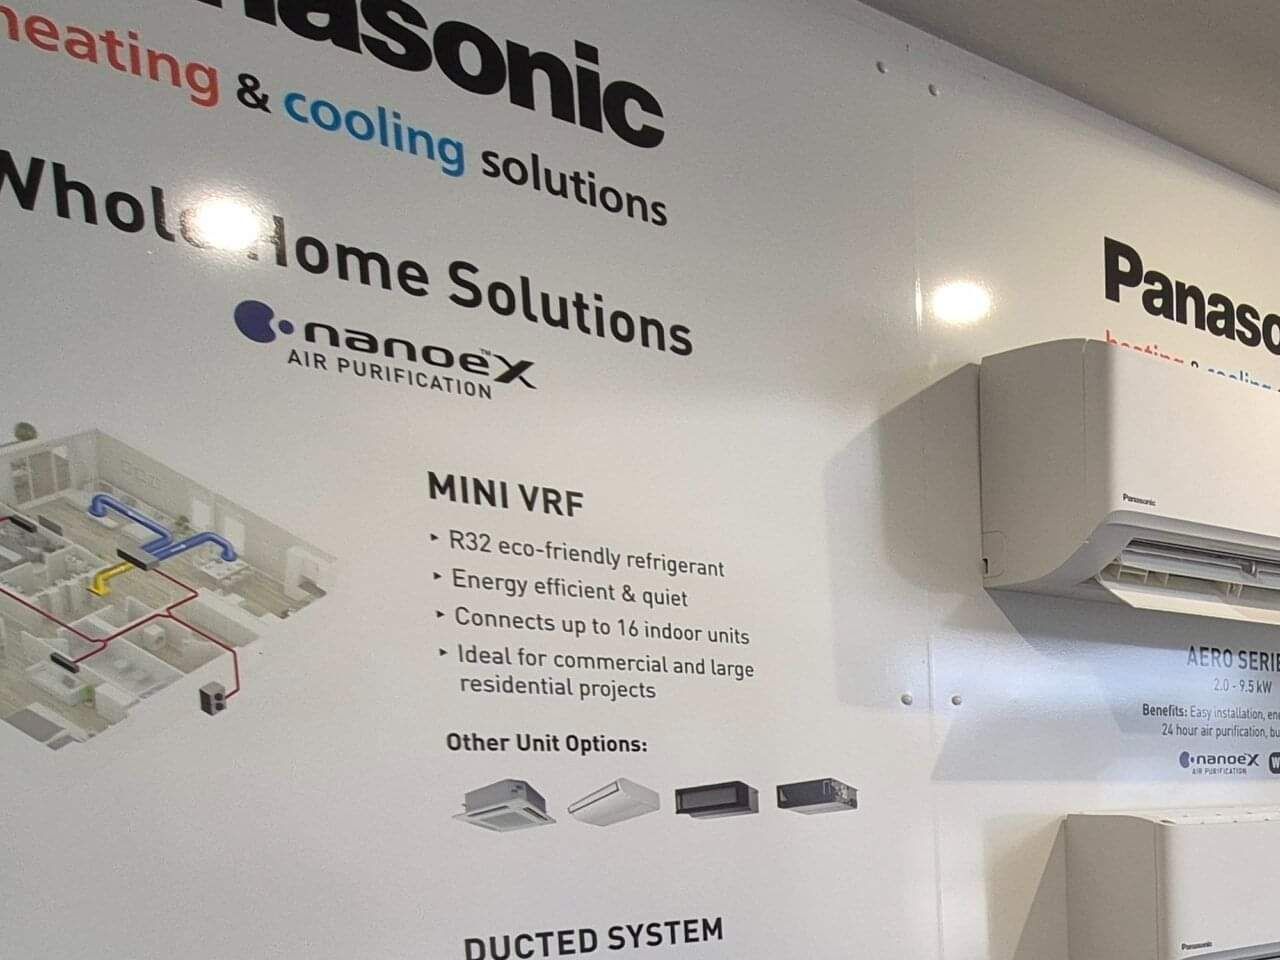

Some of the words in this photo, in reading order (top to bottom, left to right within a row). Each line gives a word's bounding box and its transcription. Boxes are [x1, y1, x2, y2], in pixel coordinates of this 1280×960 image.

[197, 0, 665, 149] asonic
[237, 73, 271, 113] &
[284, 92, 465, 177] cooling
[482, 148, 668, 227] solutions
[448, 261, 693, 357] Solutions
[288, 348, 328, 371] AIR
[337, 357, 493, 400] PURIFICATION
[427, 471, 509, 509] MINI
[518, 484, 584, 517] VRF
[449, 530, 492, 554] R32
[499, 538, 621, 570] eco-friendly
[627, 552, 725, 578] refrigerant
[452, 569, 528, 597] Energy
[535, 578, 615, 602] efficient
[622, 584, 636, 603] &
[643, 589, 688, 608] quiet
[455, 607, 555, 632] Connects
[562, 618, 586, 637] up
[592, 618, 611, 636] to
[617, 619, 639, 638] 16
[644, 622, 702, 641] indoor
[708, 626, 750, 645] units
[458, 645, 512, 665] Ideal
[518, 648, 547, 667] for
[553, 654, 668, 674] commercial
[673, 658, 705, 675] and
[711, 659, 755, 681] large
[1187, 645, 1233, 669] AERO
[460, 676, 573, 696] residential
[579, 679, 657, 702] projects
[1143, 703, 1188, 718] Benefits:
[1190, 705, 1212, 721] Easy
[1214, 706, 1266, 721] installation,
[446, 732, 510, 752] Other
[516, 733, 560, 752] Unit
[566, 734, 648, 756] Options:
[1162, 723, 1173, 736] 24
[1176, 723, 1198, 737] hour
[1201, 725, 1213, 738] air
[1216, 725, 1267, 740] purification,
[607, 917, 723, 950] SYSTEM
